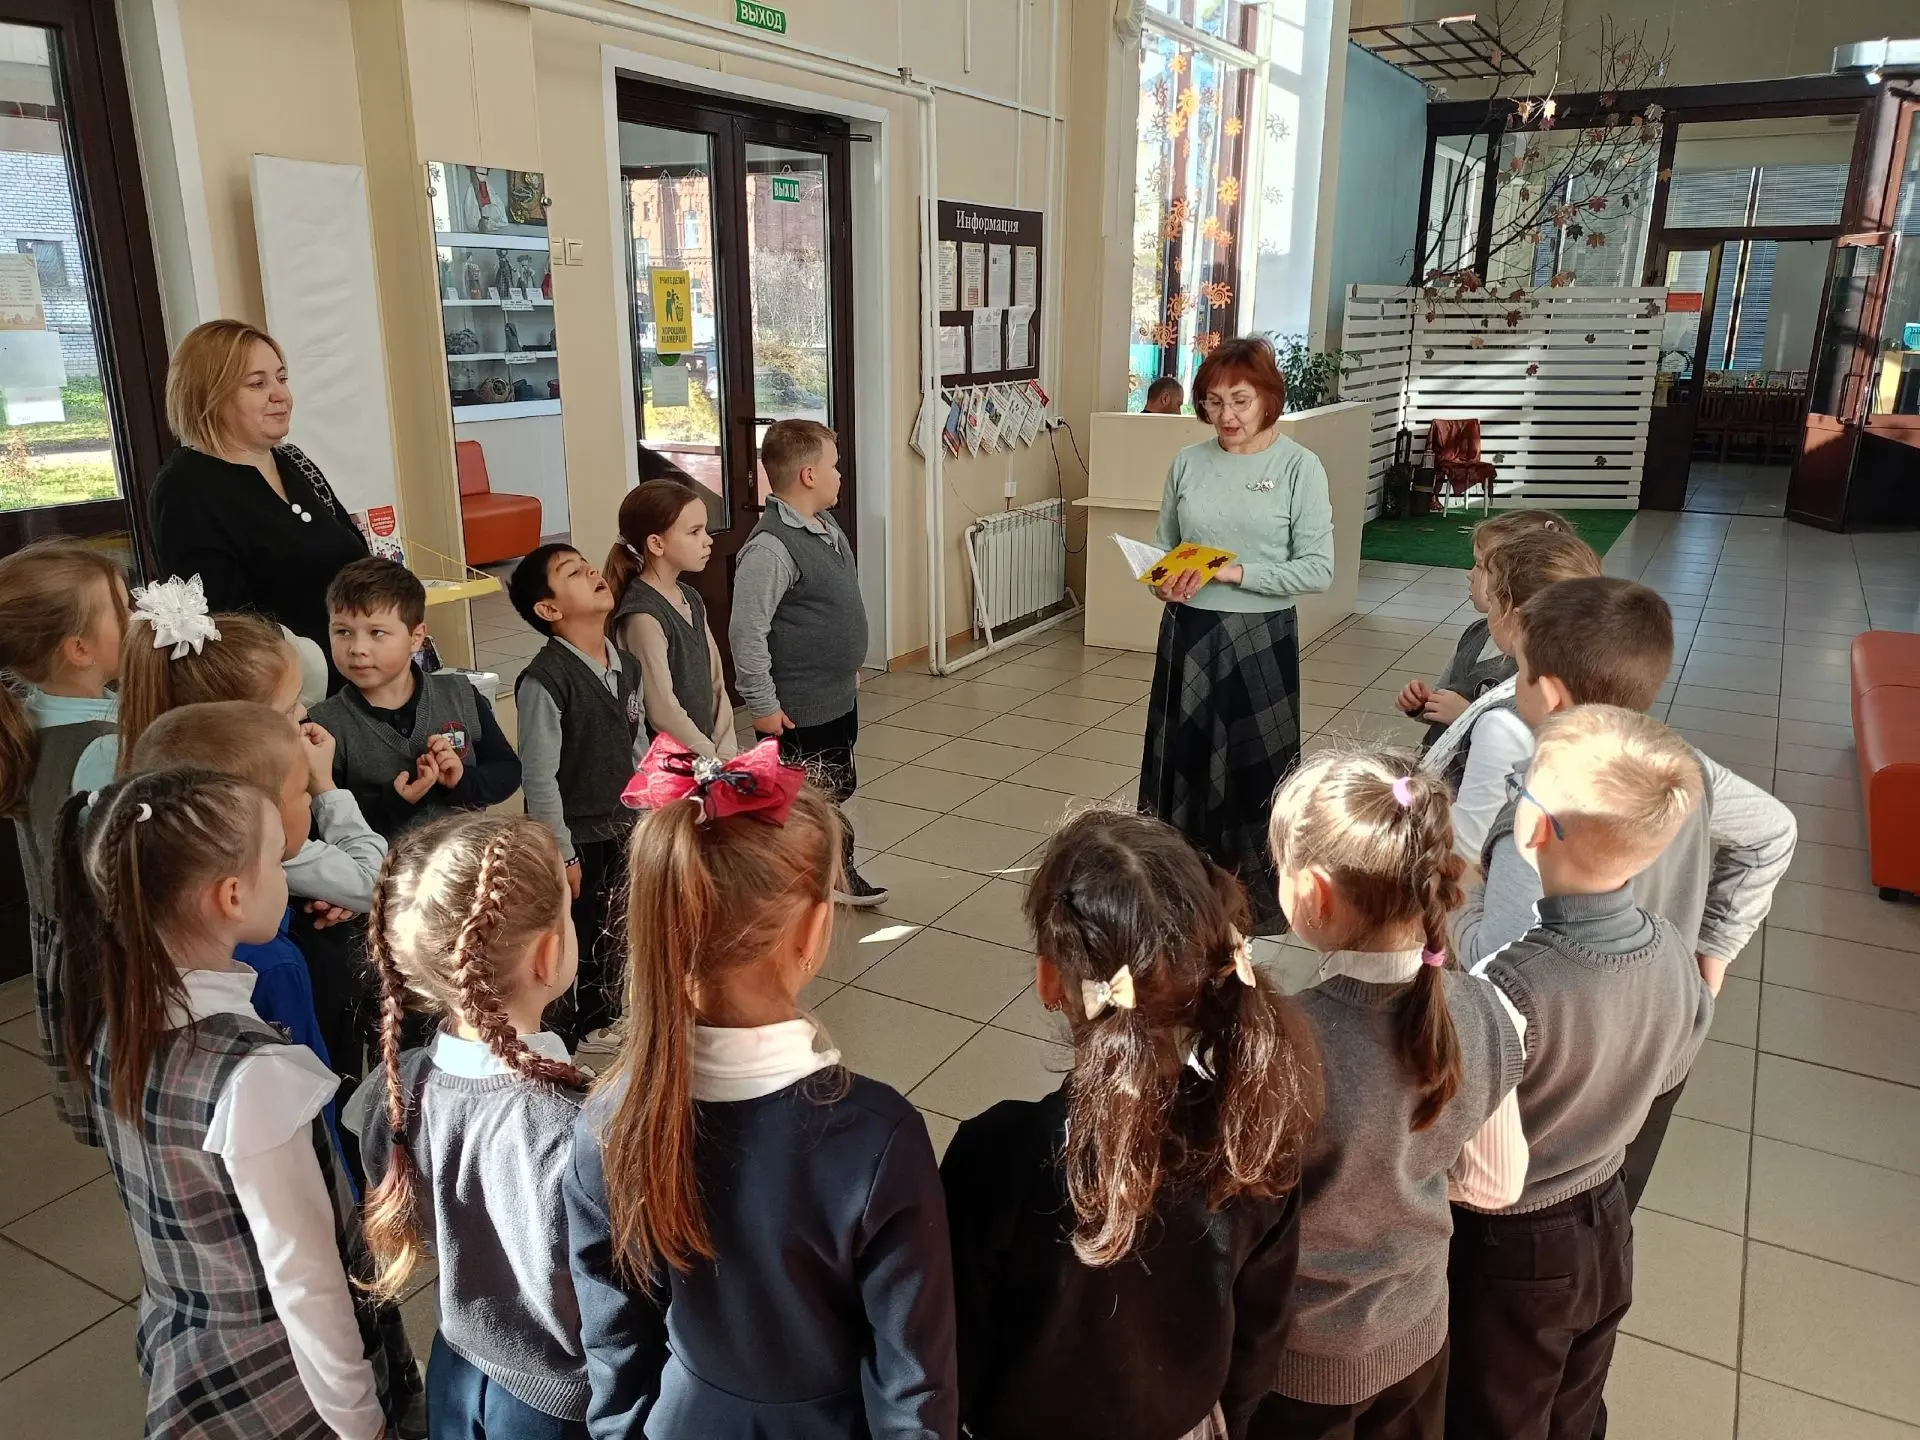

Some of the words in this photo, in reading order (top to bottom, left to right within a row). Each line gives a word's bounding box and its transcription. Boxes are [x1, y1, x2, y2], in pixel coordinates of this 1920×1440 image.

[740, 3, 782, 31] ВЫХОД
[774, 182, 800, 201] ВЫХОД
[956, 210, 1019, 236] Информация
